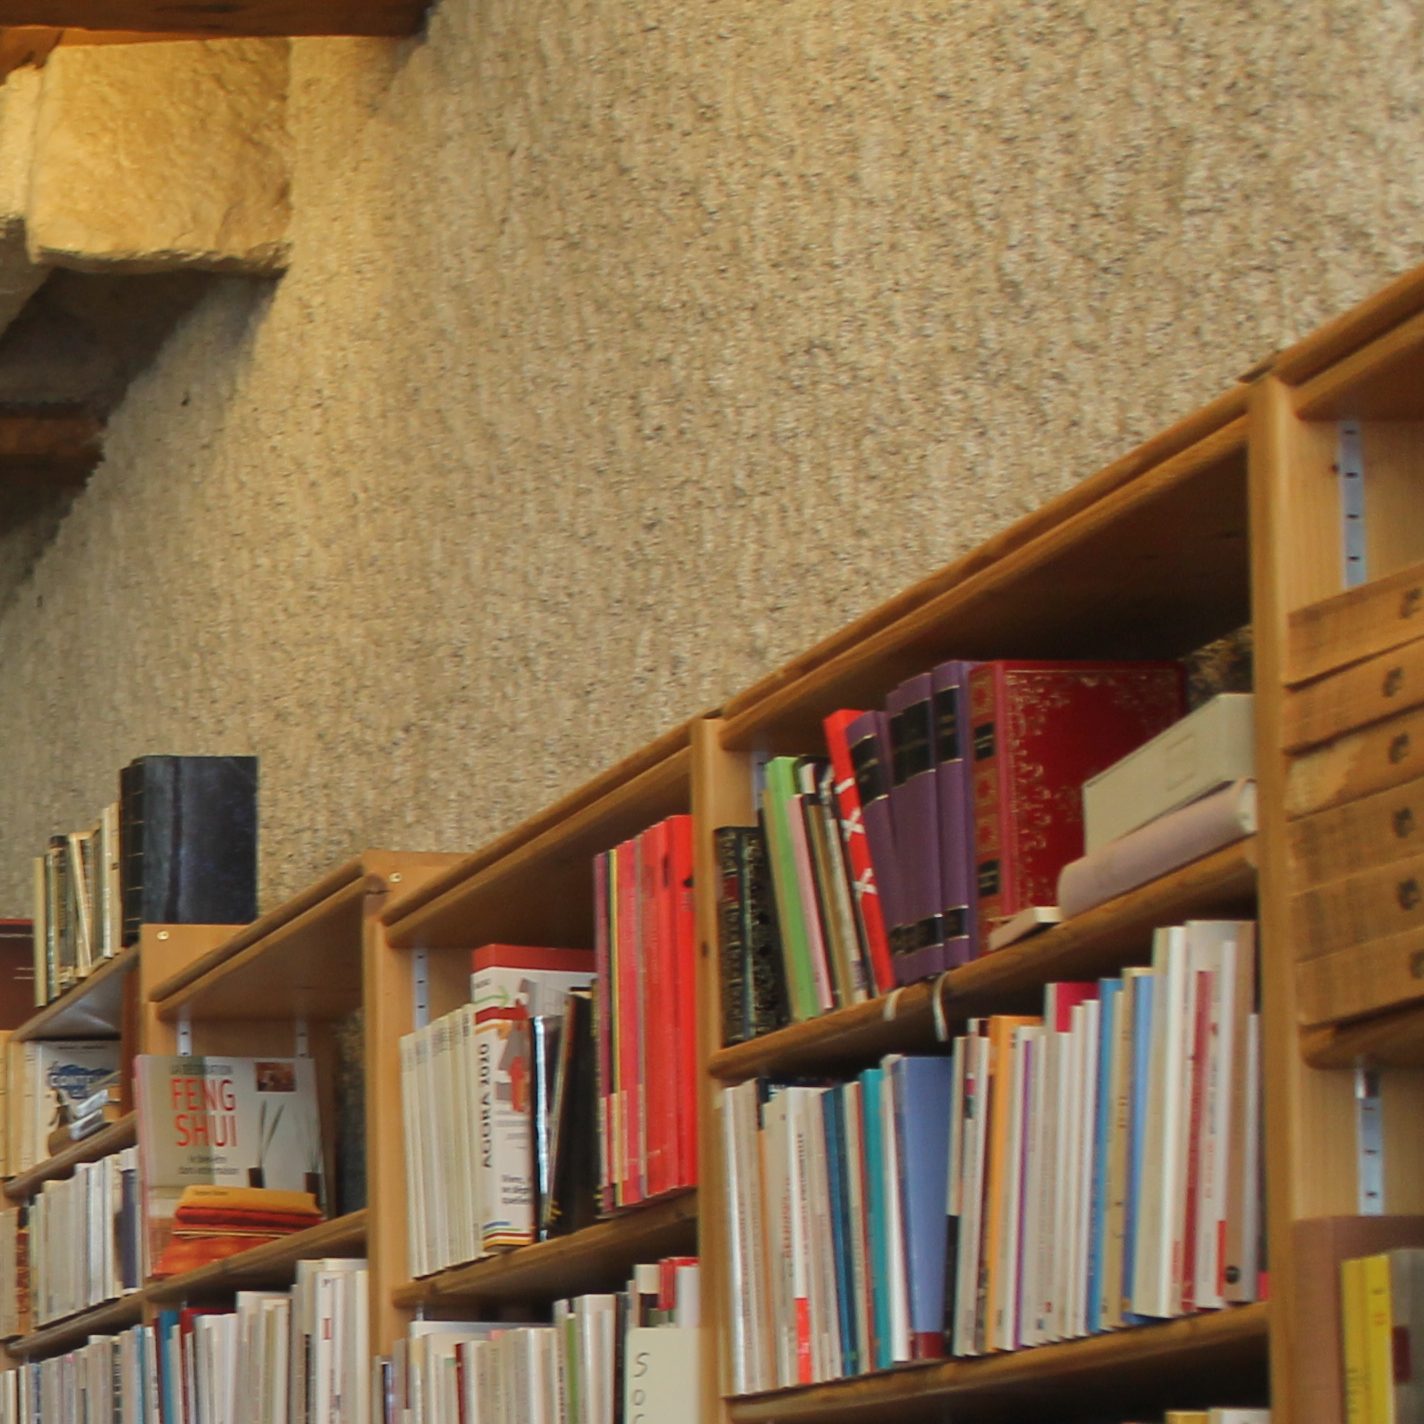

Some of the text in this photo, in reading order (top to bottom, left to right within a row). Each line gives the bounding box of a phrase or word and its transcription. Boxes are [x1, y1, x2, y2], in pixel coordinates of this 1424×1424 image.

[171, 1078, 236, 1111] FENG
[478, 1043, 493, 1168] AGORA 2020
[175, 1114, 237, 1146] SHUI
